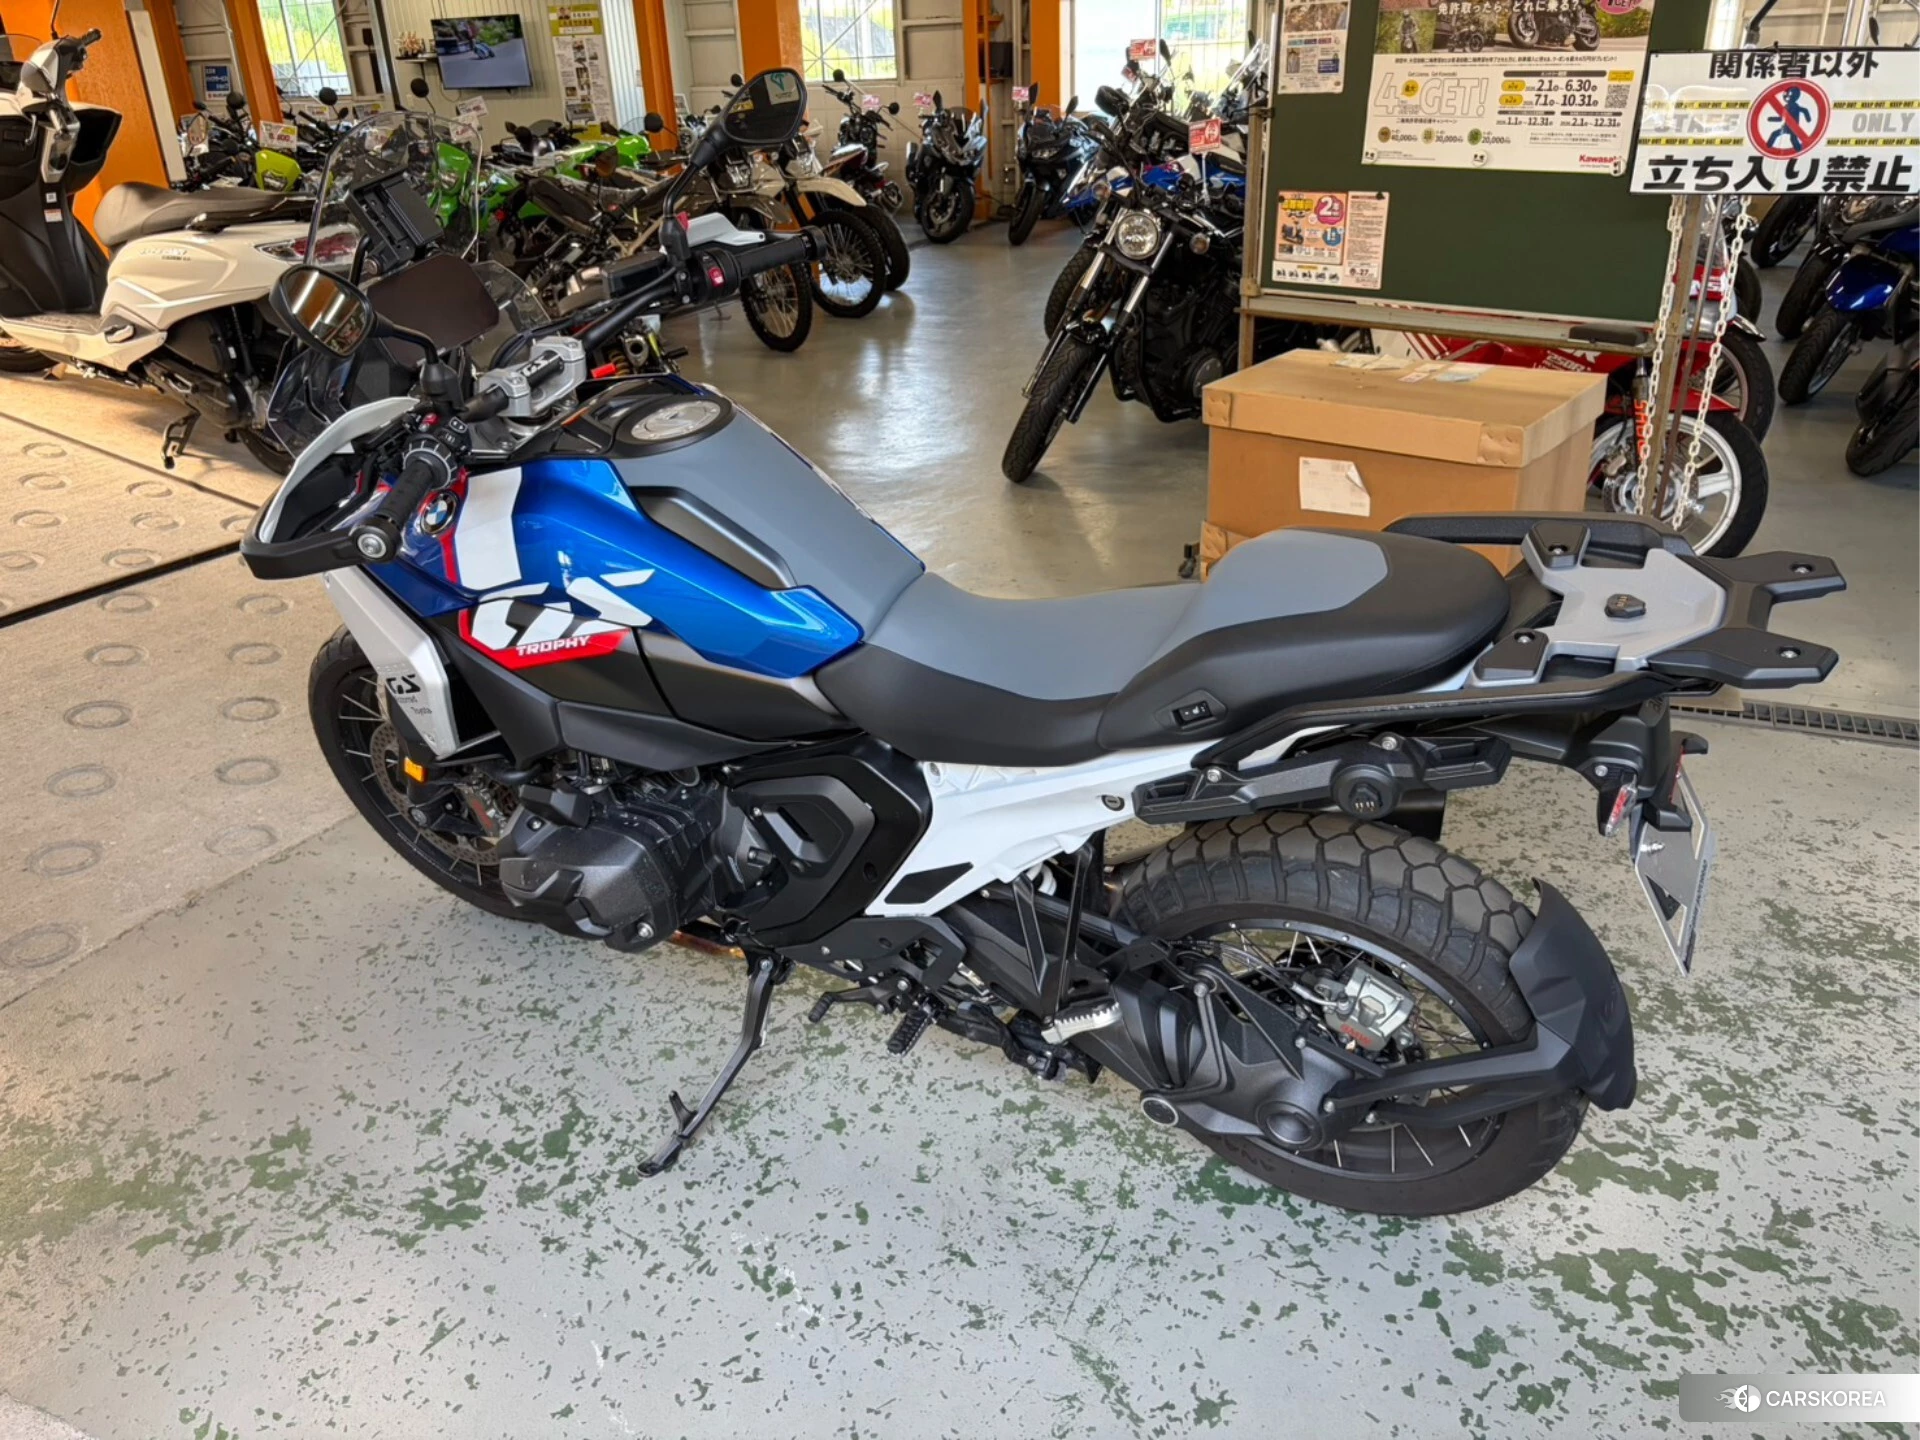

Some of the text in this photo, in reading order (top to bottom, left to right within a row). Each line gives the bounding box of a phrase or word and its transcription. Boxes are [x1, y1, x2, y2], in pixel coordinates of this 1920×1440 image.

[1709, 52, 1879, 79] 関係者以外
[1852, 112, 1915, 133] ONLY
[1643, 155, 1912, 192] 立ち入り禁止
[516, 636, 591, 656] TROPHY
[386, 674, 421, 695] GS
